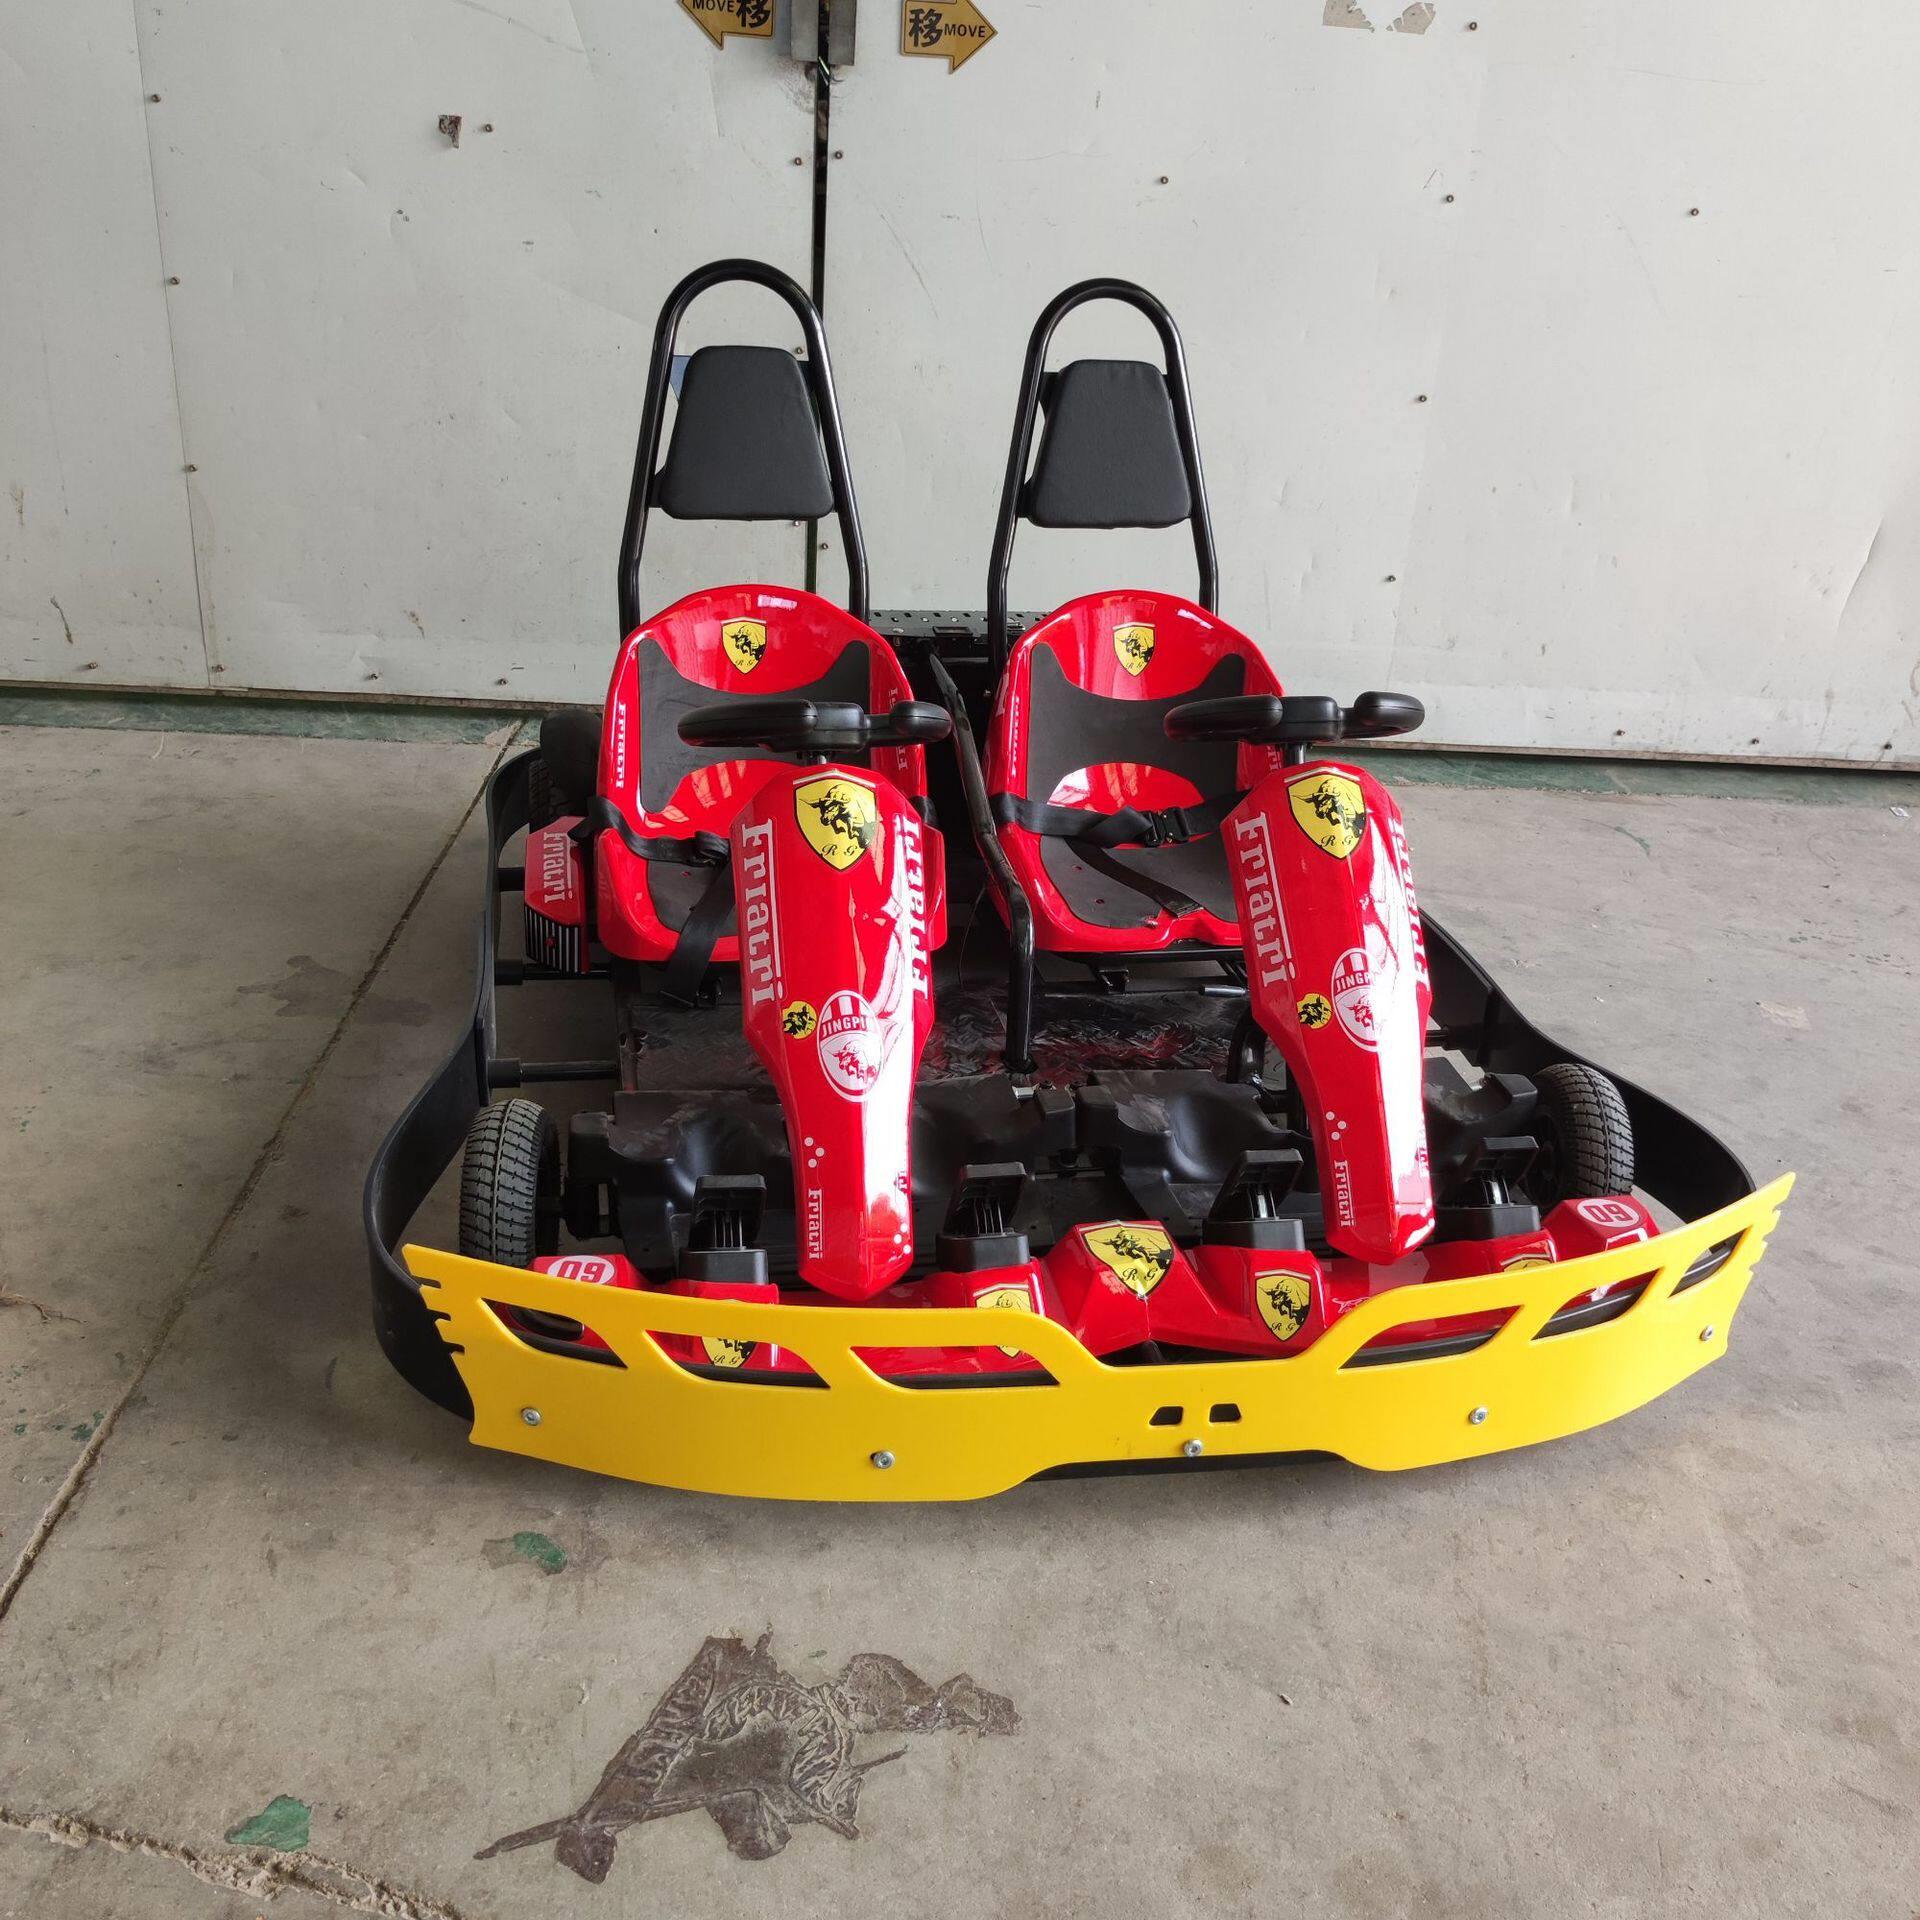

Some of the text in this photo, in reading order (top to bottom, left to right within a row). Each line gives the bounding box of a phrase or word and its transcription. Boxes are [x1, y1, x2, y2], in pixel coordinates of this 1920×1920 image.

[692, 0, 771, 28] MOVE 移
[908, 8, 986, 47] 移 MOVE
[543, 832, 573, 904] Friatri
[742, 818, 784, 1003] Friatri
[897, 817, 929, 1001] Friatri
[1236, 812, 1296, 987] Friatri
[1335, 972, 1372, 993] JINGP
[822, 1015, 872, 1038] JINGPI
[1334, 1159, 1355, 1228] Friatri
[1583, 1204, 1633, 1223] 09
[807, 1187, 822, 1260] Friatri
[556, 1260, 606, 1283] 09
